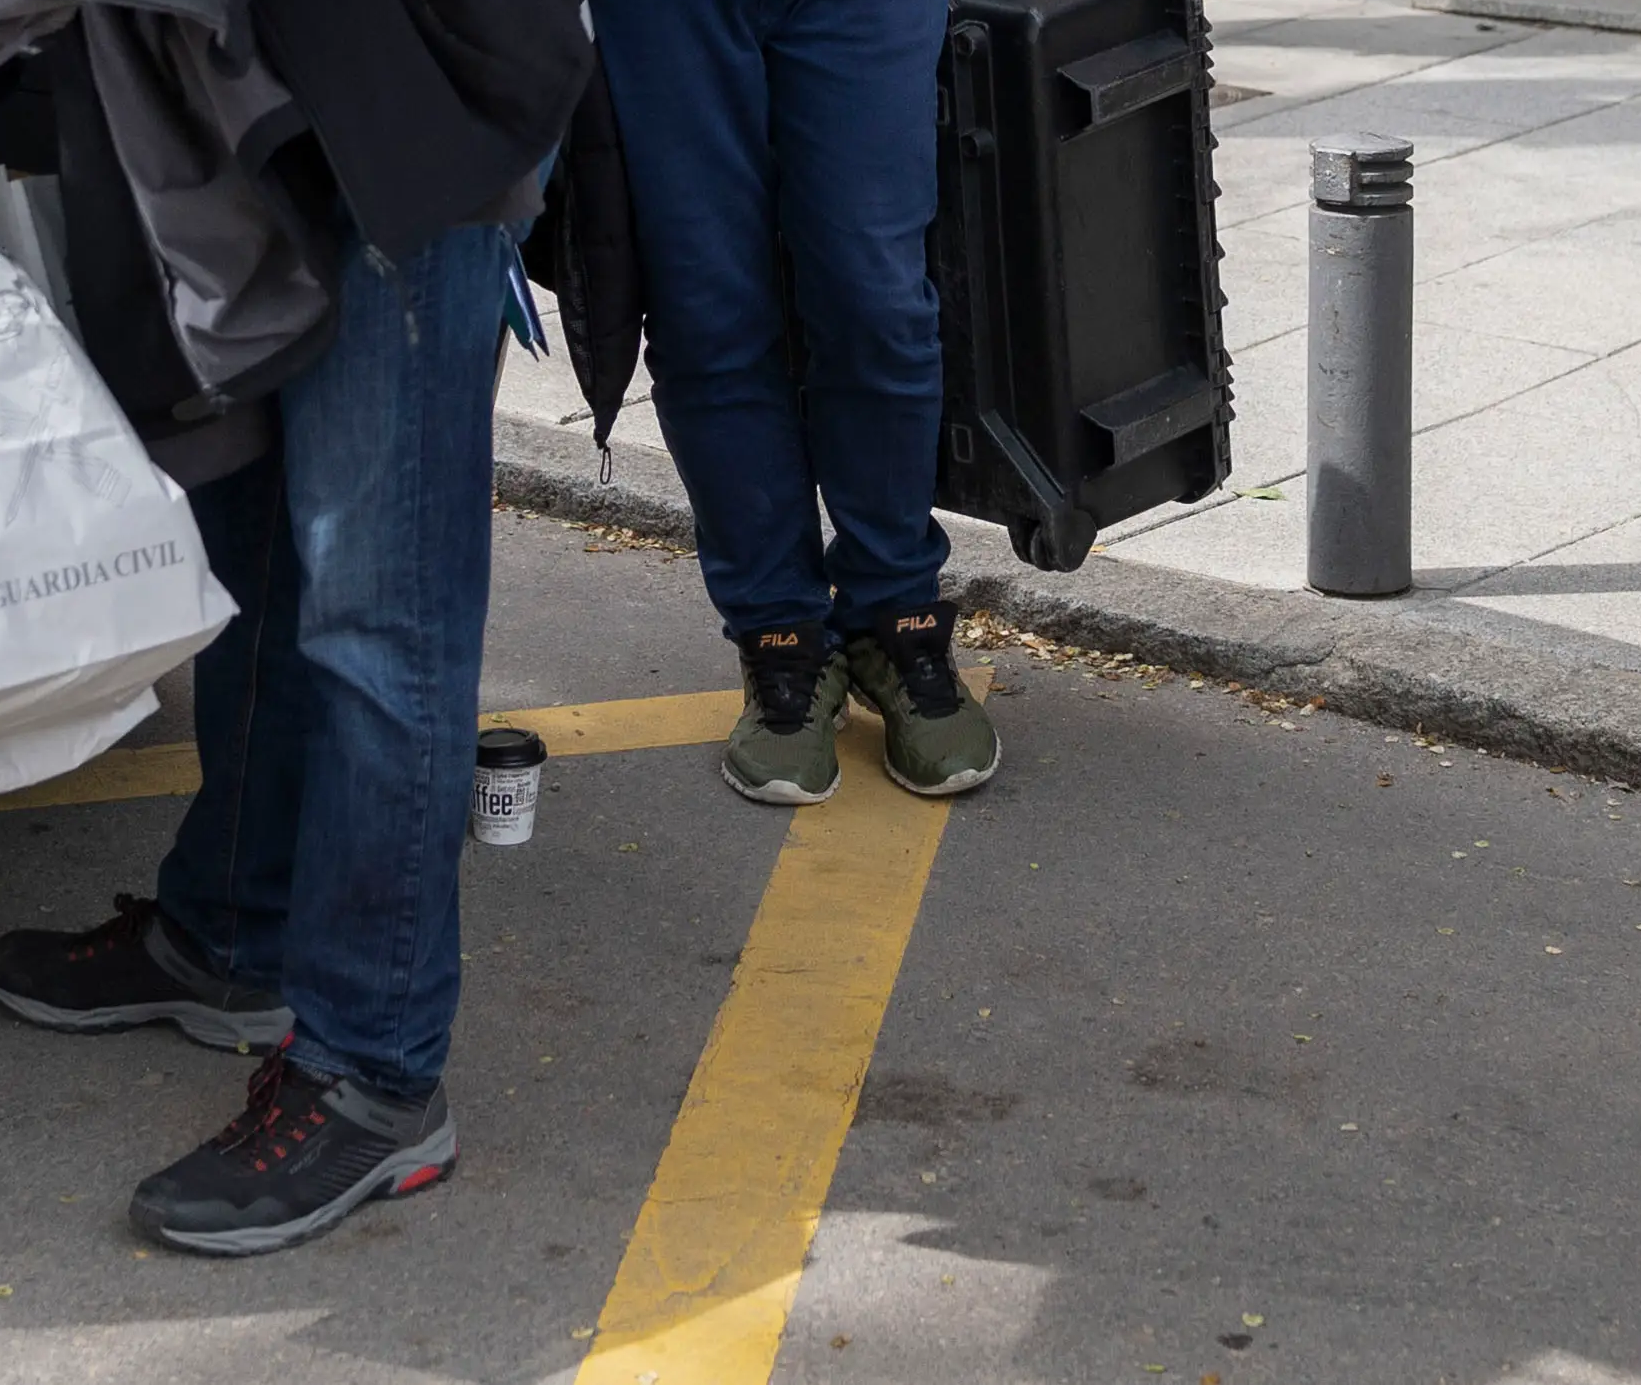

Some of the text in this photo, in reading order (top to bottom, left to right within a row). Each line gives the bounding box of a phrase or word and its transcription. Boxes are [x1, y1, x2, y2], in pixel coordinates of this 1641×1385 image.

[114, 540, 185, 577] CIVIL
[896, 614, 938, 633] FILA
[760, 632, 798, 648] FILA
[472, 783, 512, 815] ffee
